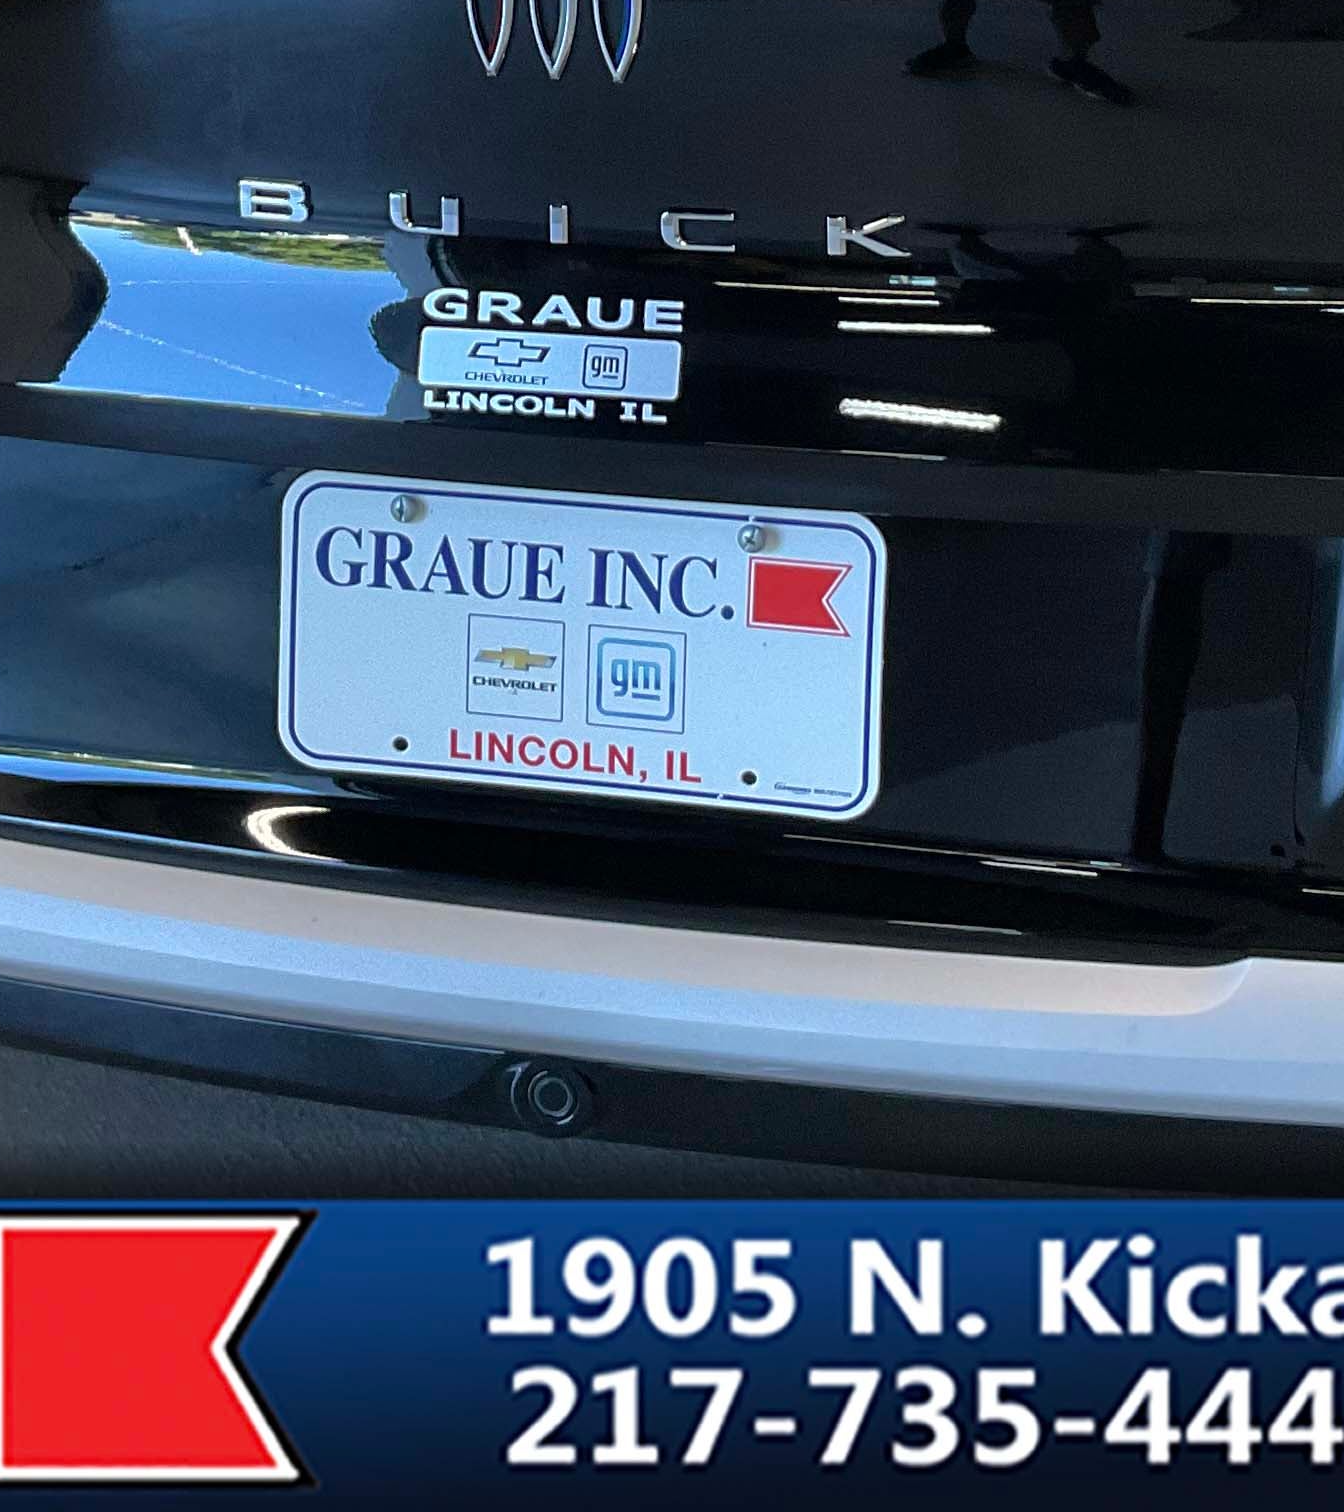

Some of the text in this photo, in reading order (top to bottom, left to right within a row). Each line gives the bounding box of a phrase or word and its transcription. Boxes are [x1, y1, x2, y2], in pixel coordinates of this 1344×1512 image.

[238, 178, 914, 258] BUICK
[423, 288, 685, 333] GRAUE
[464, 370, 549, 386] CHEVROLET
[590, 354, 620, 380] gm
[423, 390, 668, 424] LINCOLN IL
[315, 526, 736, 621] GRAUE INC.
[472, 675, 558, 693] CHEVROLET
[610, 658, 662, 701] gm
[449, 727, 702, 783] LINCOLN, IL
